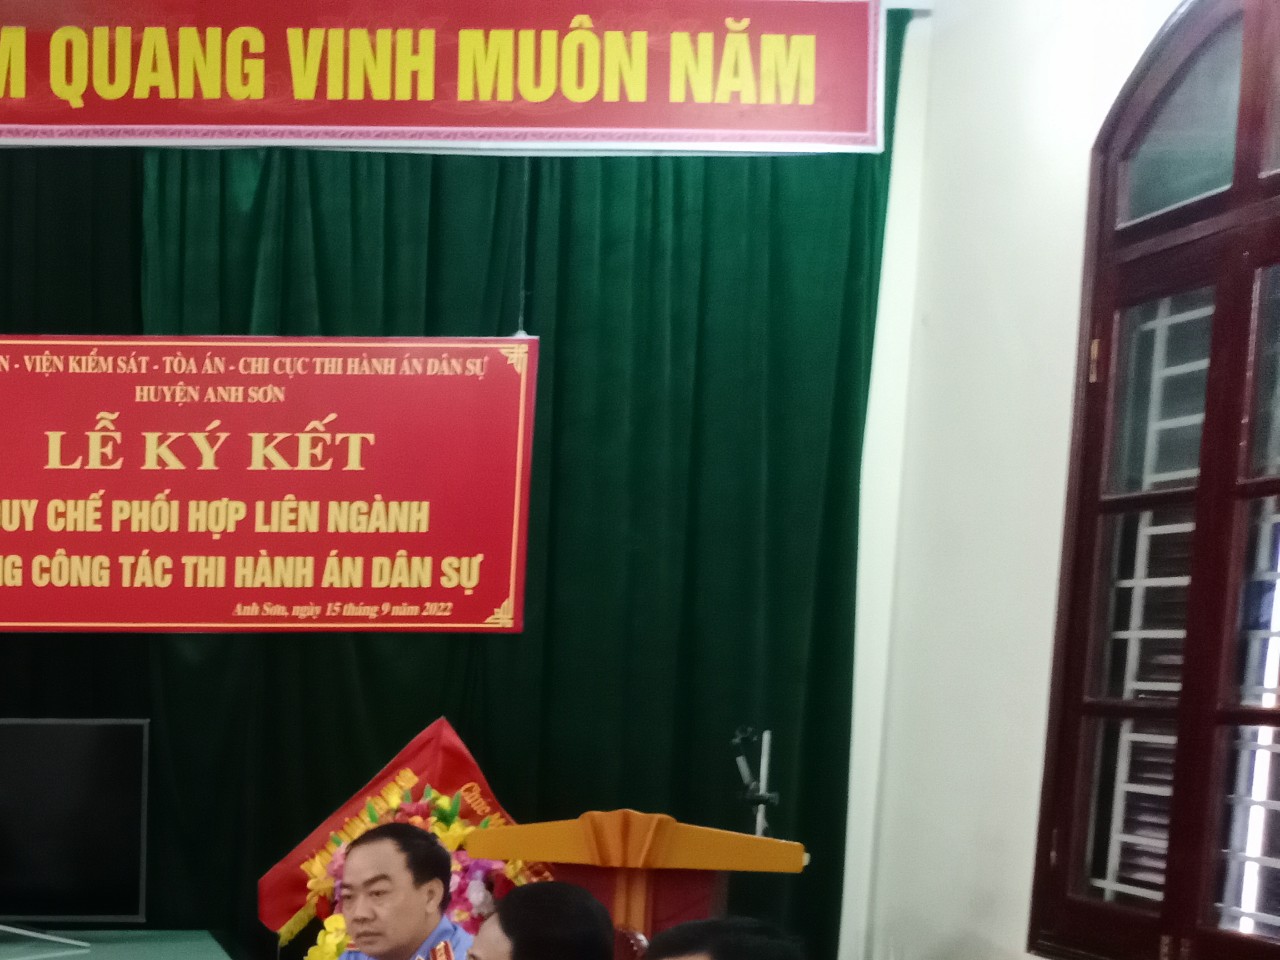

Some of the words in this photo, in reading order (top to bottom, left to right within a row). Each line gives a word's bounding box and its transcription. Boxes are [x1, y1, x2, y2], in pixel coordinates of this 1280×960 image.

[48, 26, 265, 109] QUANG
[287, 28, 435, 102] VINH
[458, 14, 648, 104] MUÔN
[669, 17, 817, 106] NĂM
[23, 350, 64, 378] VIỆN
[68, 347, 113, 374] KIỂM
[116, 351, 150, 374] SÁT
[162, 351, 197, 374] TÒA
[201, 351, 226, 375] ÁN
[238, 356, 270, 375] CHI
[273, 356, 310, 379] CỤC
[312, 357, 343, 375] THI
[346, 353, 397, 376] HÀNH
[399, 353, 425, 376] ÁN
[426, 353, 463, 376] DÂN
[465, 355, 490, 381] SỰ
[134, 381, 200, 407] HUYỆN
[204, 386, 245, 403] ANH
[247, 384, 286, 403] SƠN
[44, 411, 124, 470] LỄ
[140, 419, 231, 471] KÝ
[246, 412, 376, 471] KẾT
[46, 489, 105, 532] CHẾ
[111, 489, 179, 533] PHỐI
[187, 497, 247, 540] HỢP
[254, 494, 320, 533] LIÊN
[327, 494, 430, 533] NGÀNH
[31, 548, 111, 588] CÔNG
[118, 549, 173, 588] TÁC
[181, 555, 226, 588] THI
[234, 549, 314, 588] HÀNH
[321, 549, 364, 588] ÁN
[371, 549, 433, 588] DÂN
[440, 553, 484, 595] SỰ
[232, 602, 259, 616] Anh
[291, 602, 322, 619] ngày
[325, 602, 342, 616] 15
[342, 602, 380, 619] tháng
[381, 602, 391, 615] 9
[391, 602, 420, 616] năm
[421, 602, 453, 616] 2022
